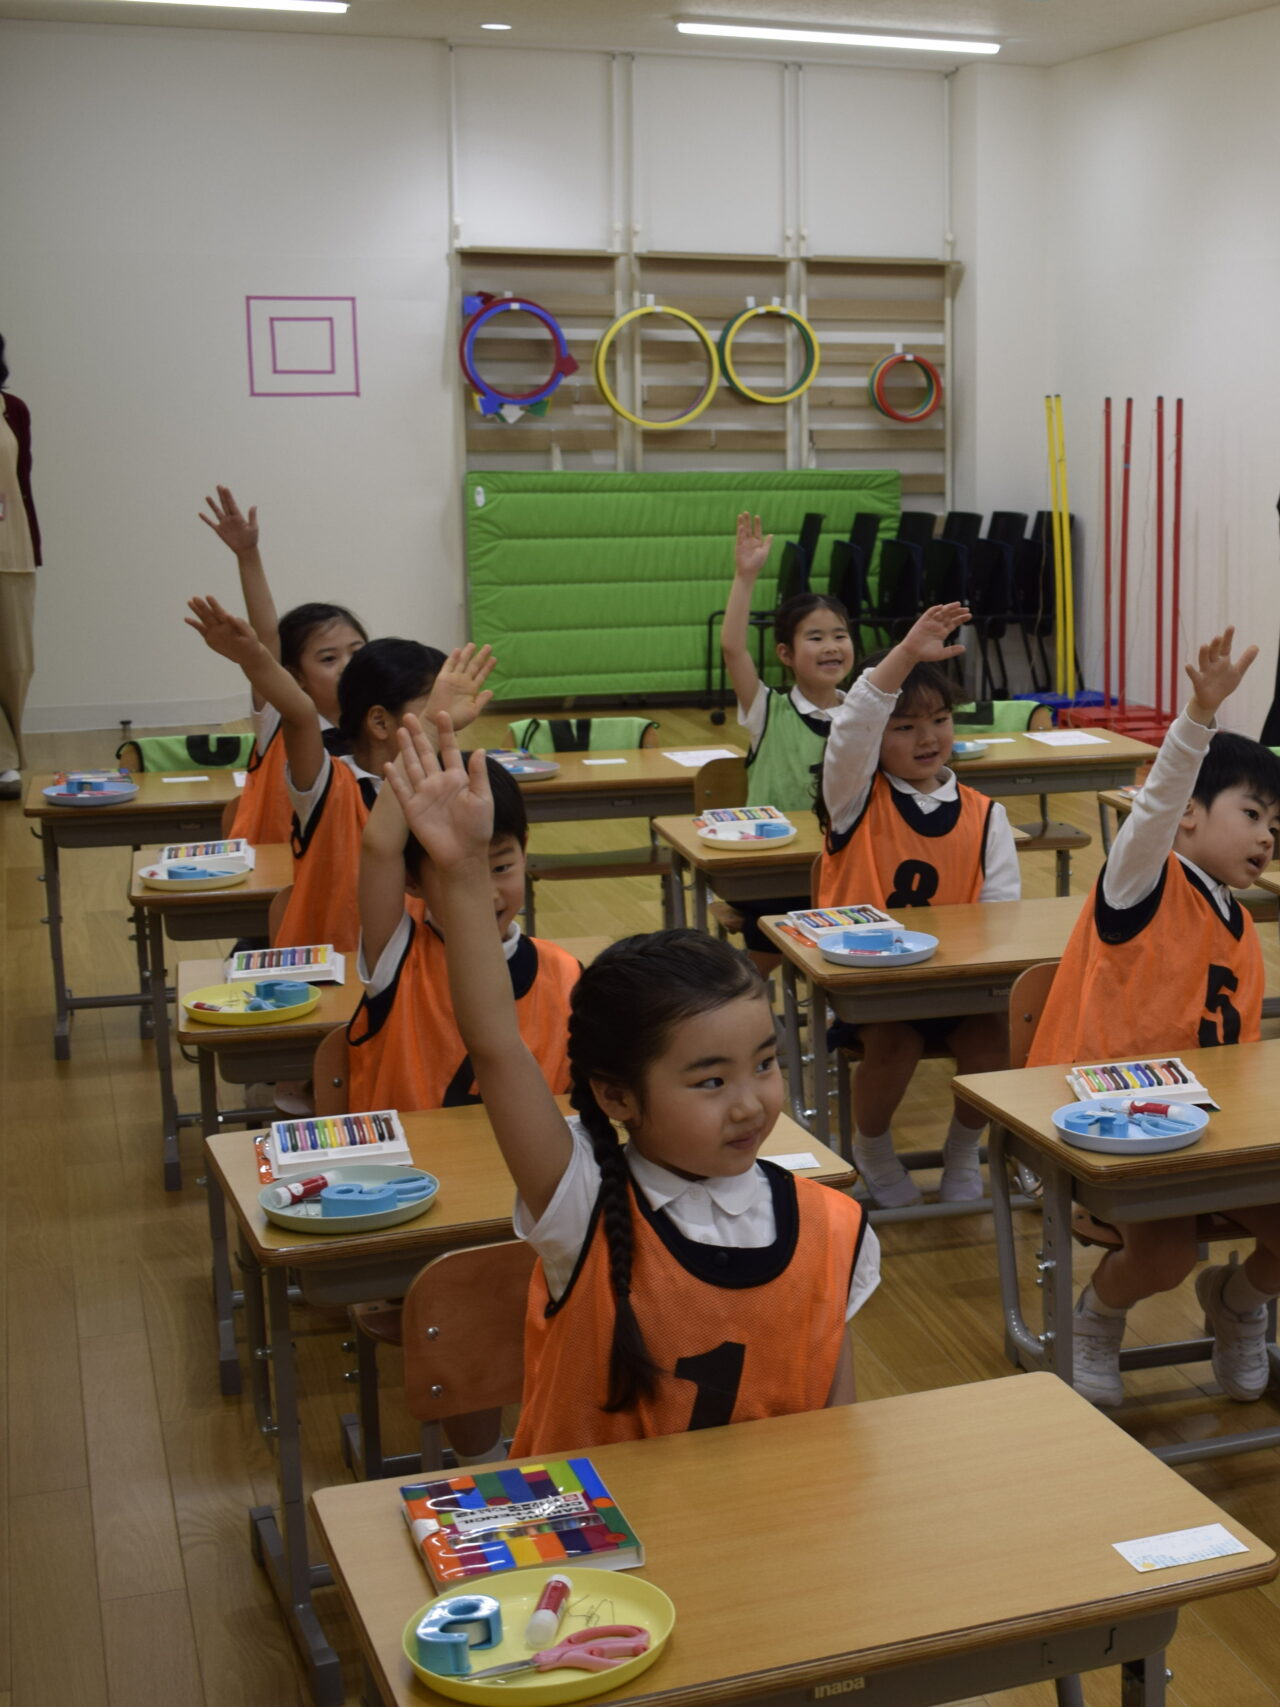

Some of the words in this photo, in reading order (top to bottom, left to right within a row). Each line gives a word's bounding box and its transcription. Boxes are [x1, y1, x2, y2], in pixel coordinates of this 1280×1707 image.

[886, 859, 938, 909] 8
[1198, 964, 1242, 1048] 5
[674, 1341, 746, 1431] 1
